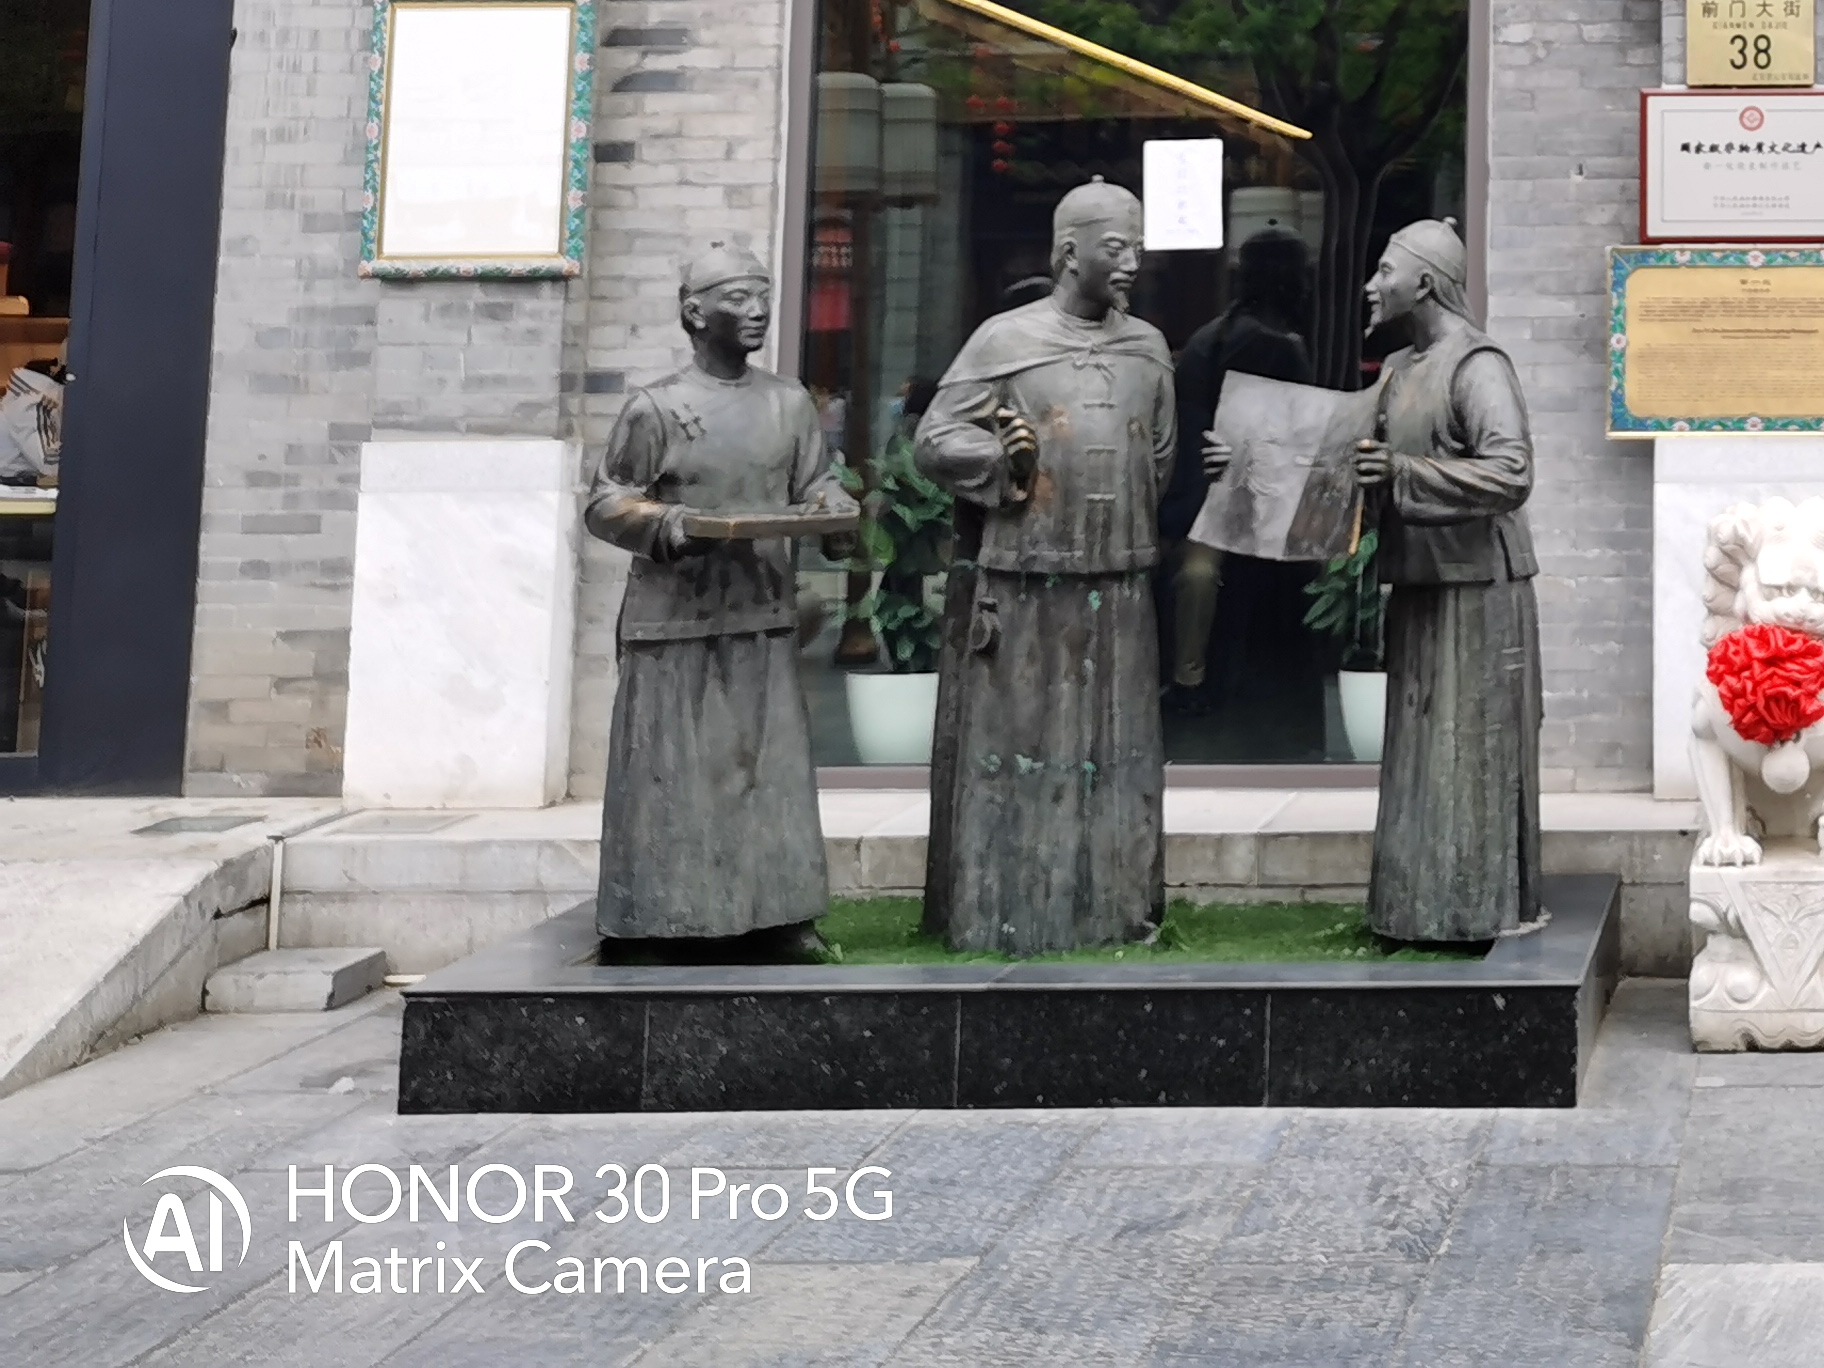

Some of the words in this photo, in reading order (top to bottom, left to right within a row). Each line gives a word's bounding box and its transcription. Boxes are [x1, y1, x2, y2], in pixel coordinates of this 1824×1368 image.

[1701, 0, 1801, 19] 前门大街
[1729, 34, 1772, 70] 38
